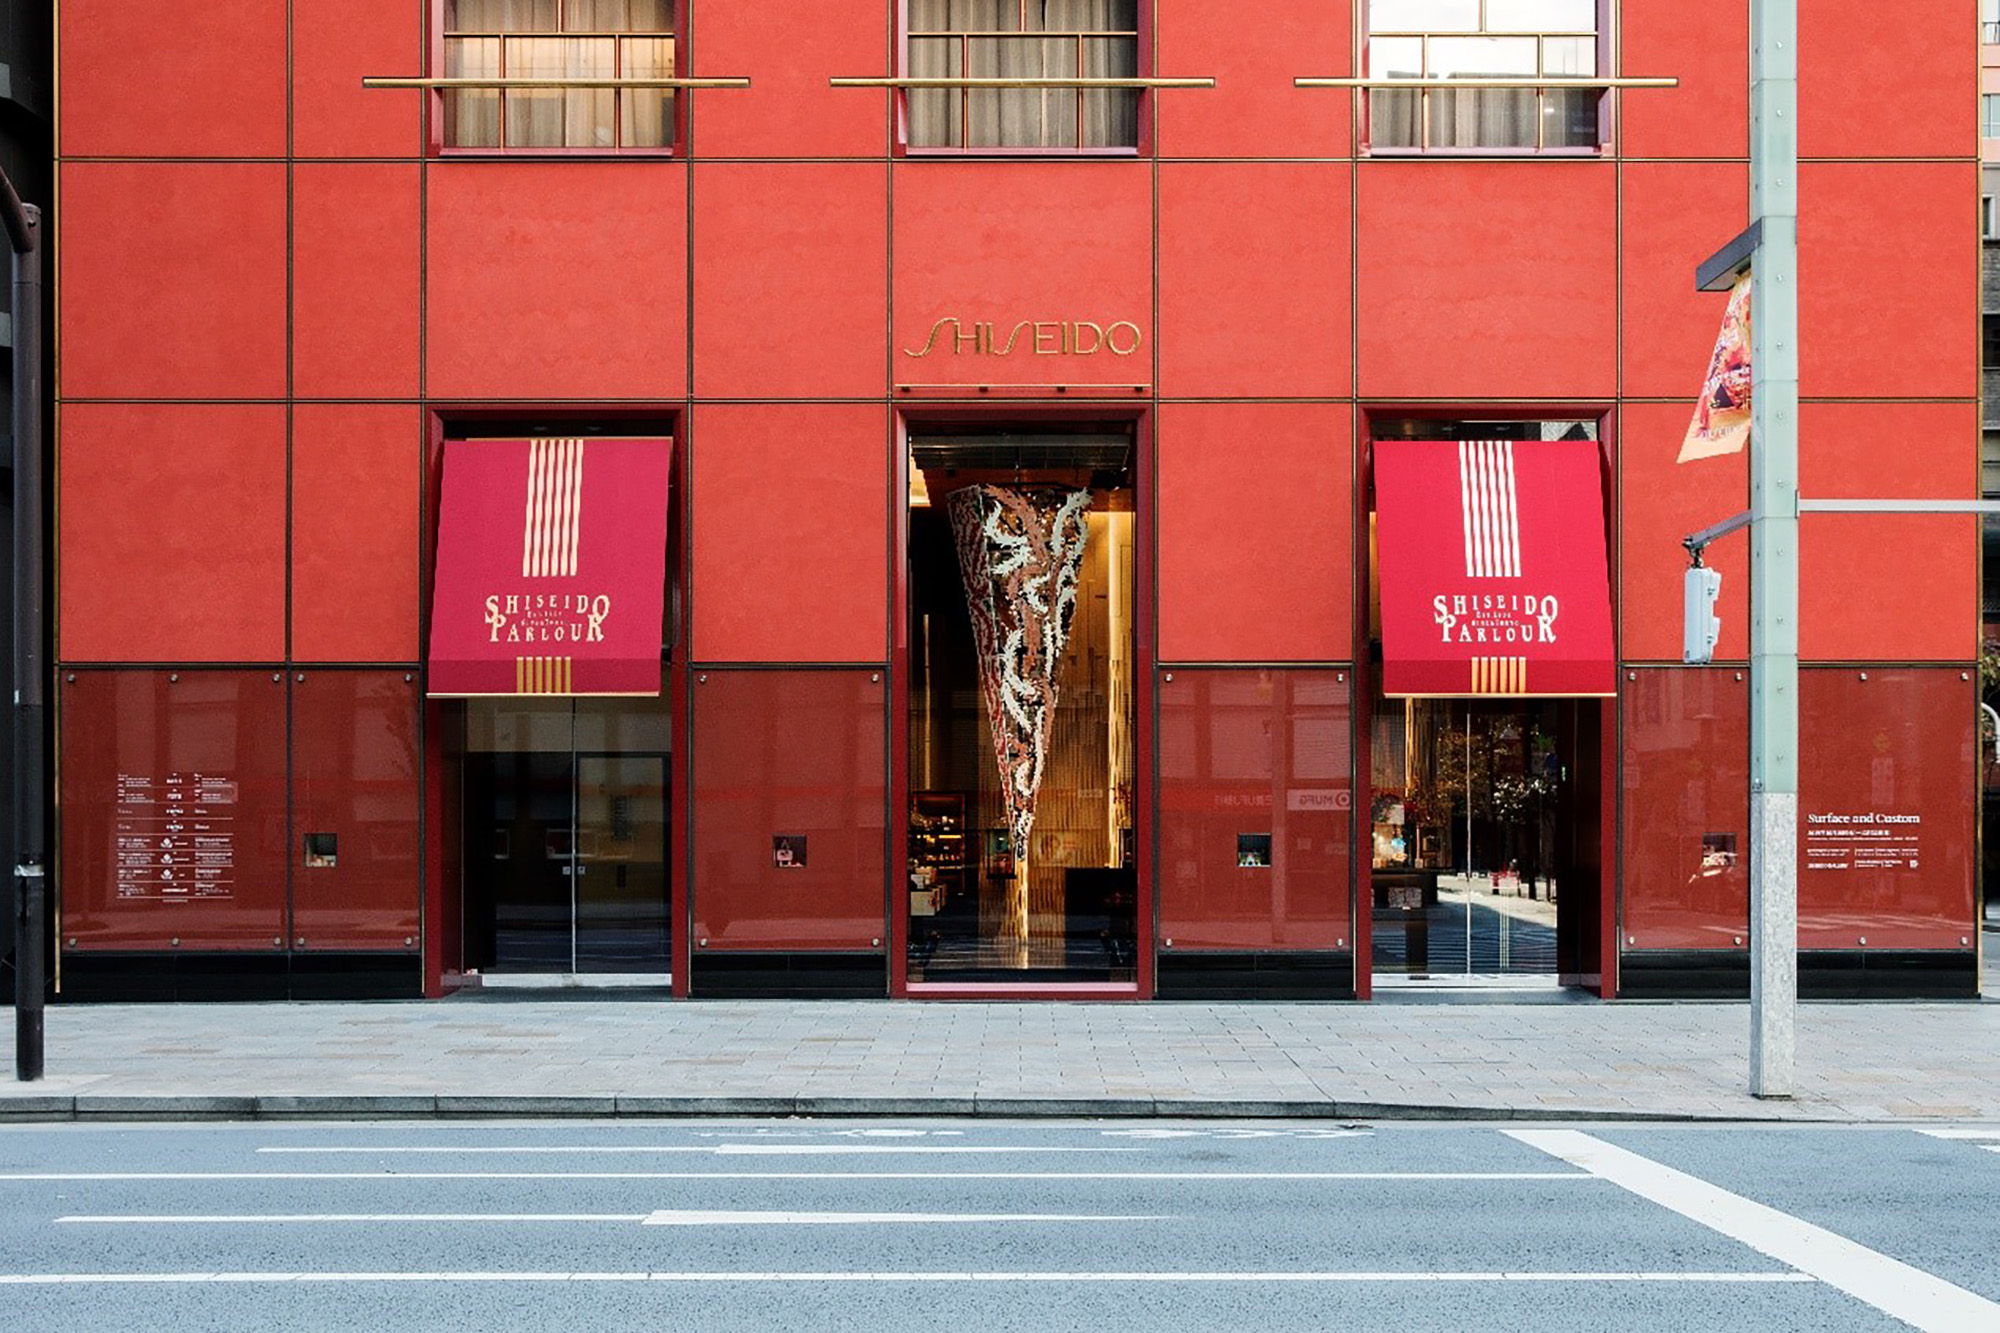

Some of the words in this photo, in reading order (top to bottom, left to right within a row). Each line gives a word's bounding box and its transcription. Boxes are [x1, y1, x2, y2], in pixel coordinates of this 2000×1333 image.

[903, 317, 1142, 357] SHISEIDO
[485, 595, 610, 624] SHISEIDO
[1433, 595, 1558, 624] SHISEIDO
[490, 614, 605, 642] PARLOUR
[1441, 614, 1557, 643] PARLOUR
[1808, 812, 1850, 824] Surface
[1852, 812, 1874, 824] and
[1875, 813, 1921, 824] Custom
